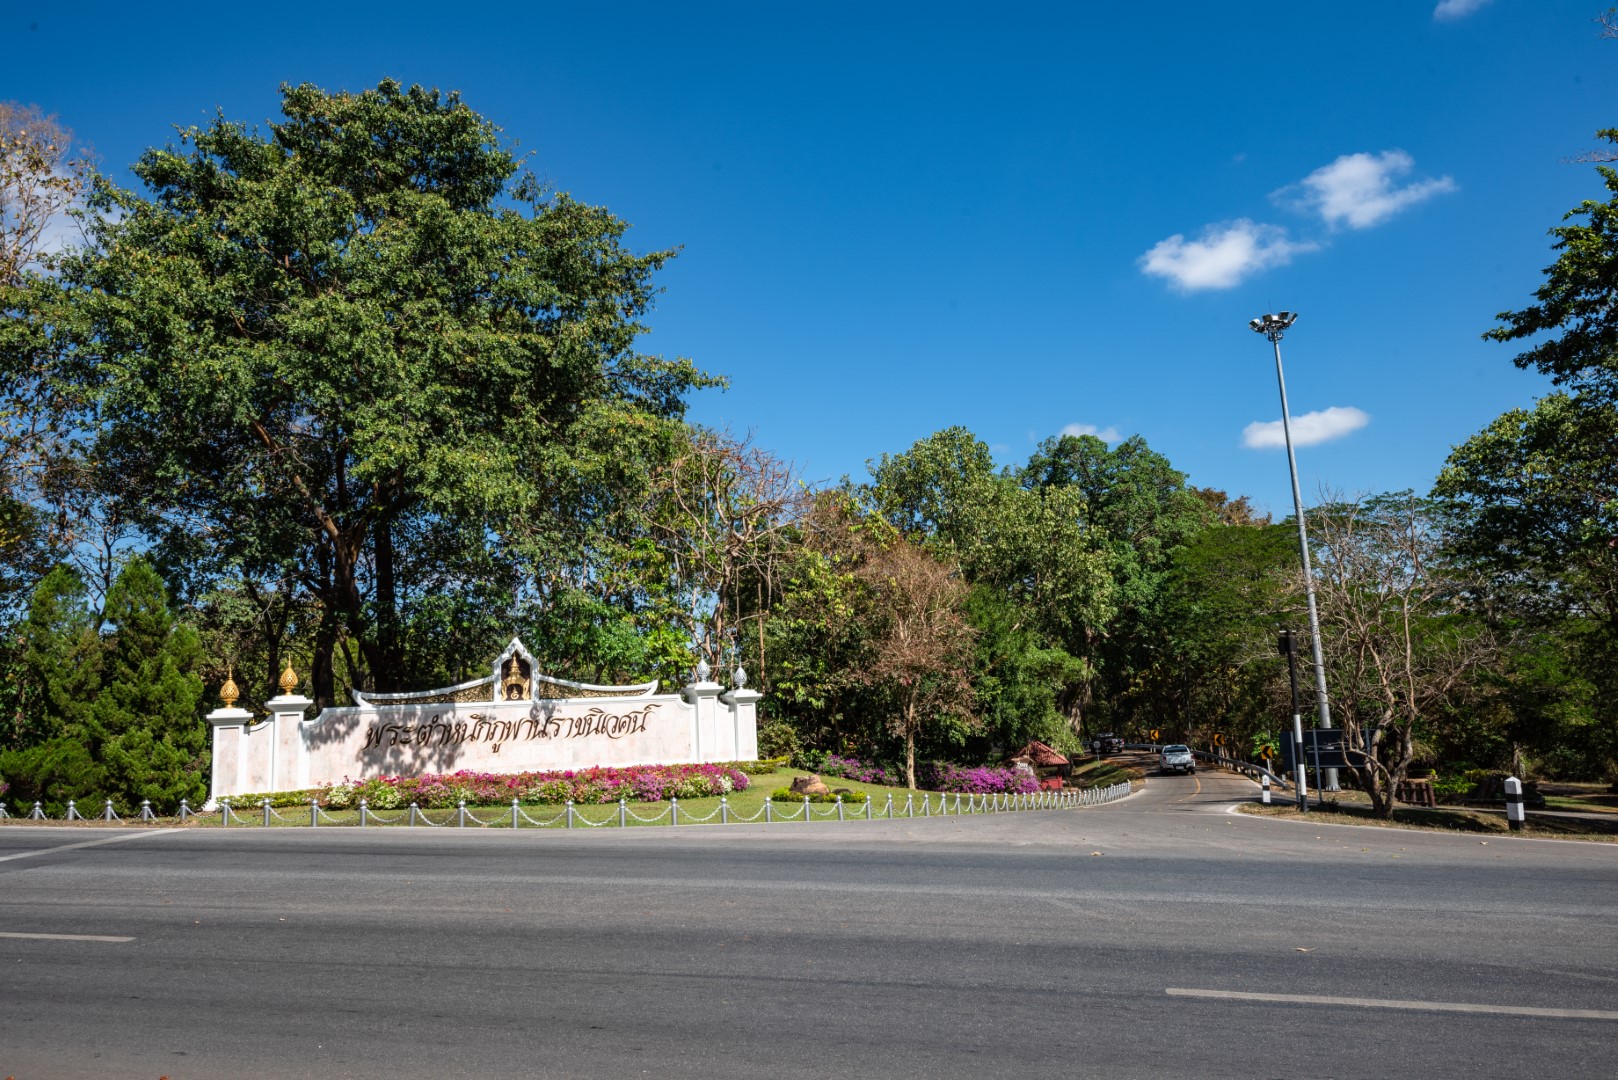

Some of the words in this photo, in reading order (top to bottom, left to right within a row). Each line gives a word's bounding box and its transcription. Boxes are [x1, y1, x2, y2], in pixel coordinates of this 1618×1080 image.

[360, 703, 662, 753] พระตำหนักภูพานราชนิเวศน์
